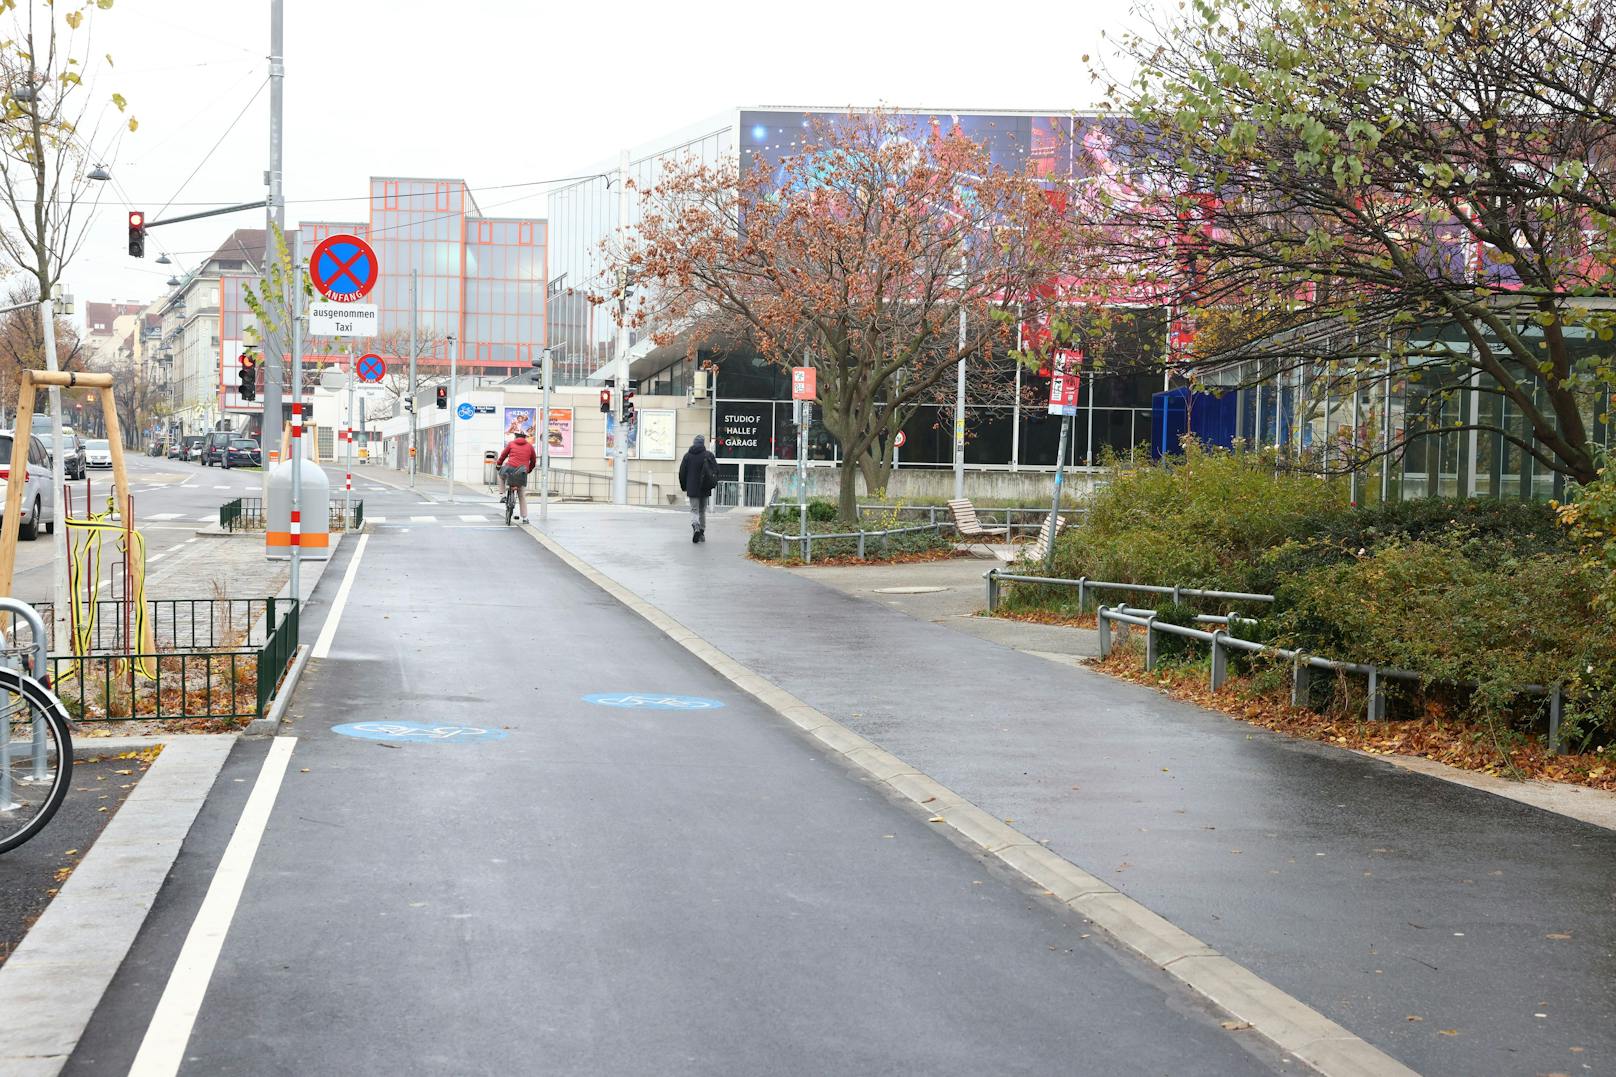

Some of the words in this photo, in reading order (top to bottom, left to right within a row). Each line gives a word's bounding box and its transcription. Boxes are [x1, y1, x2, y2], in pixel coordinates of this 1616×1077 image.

[325, 289, 363, 302] ANFANG
[313, 309, 375, 319] ausgenommen
[335, 322, 353, 332] Taxi
[725, 415, 755, 423] STUDIO
[725, 439, 757, 447] GARAGE
